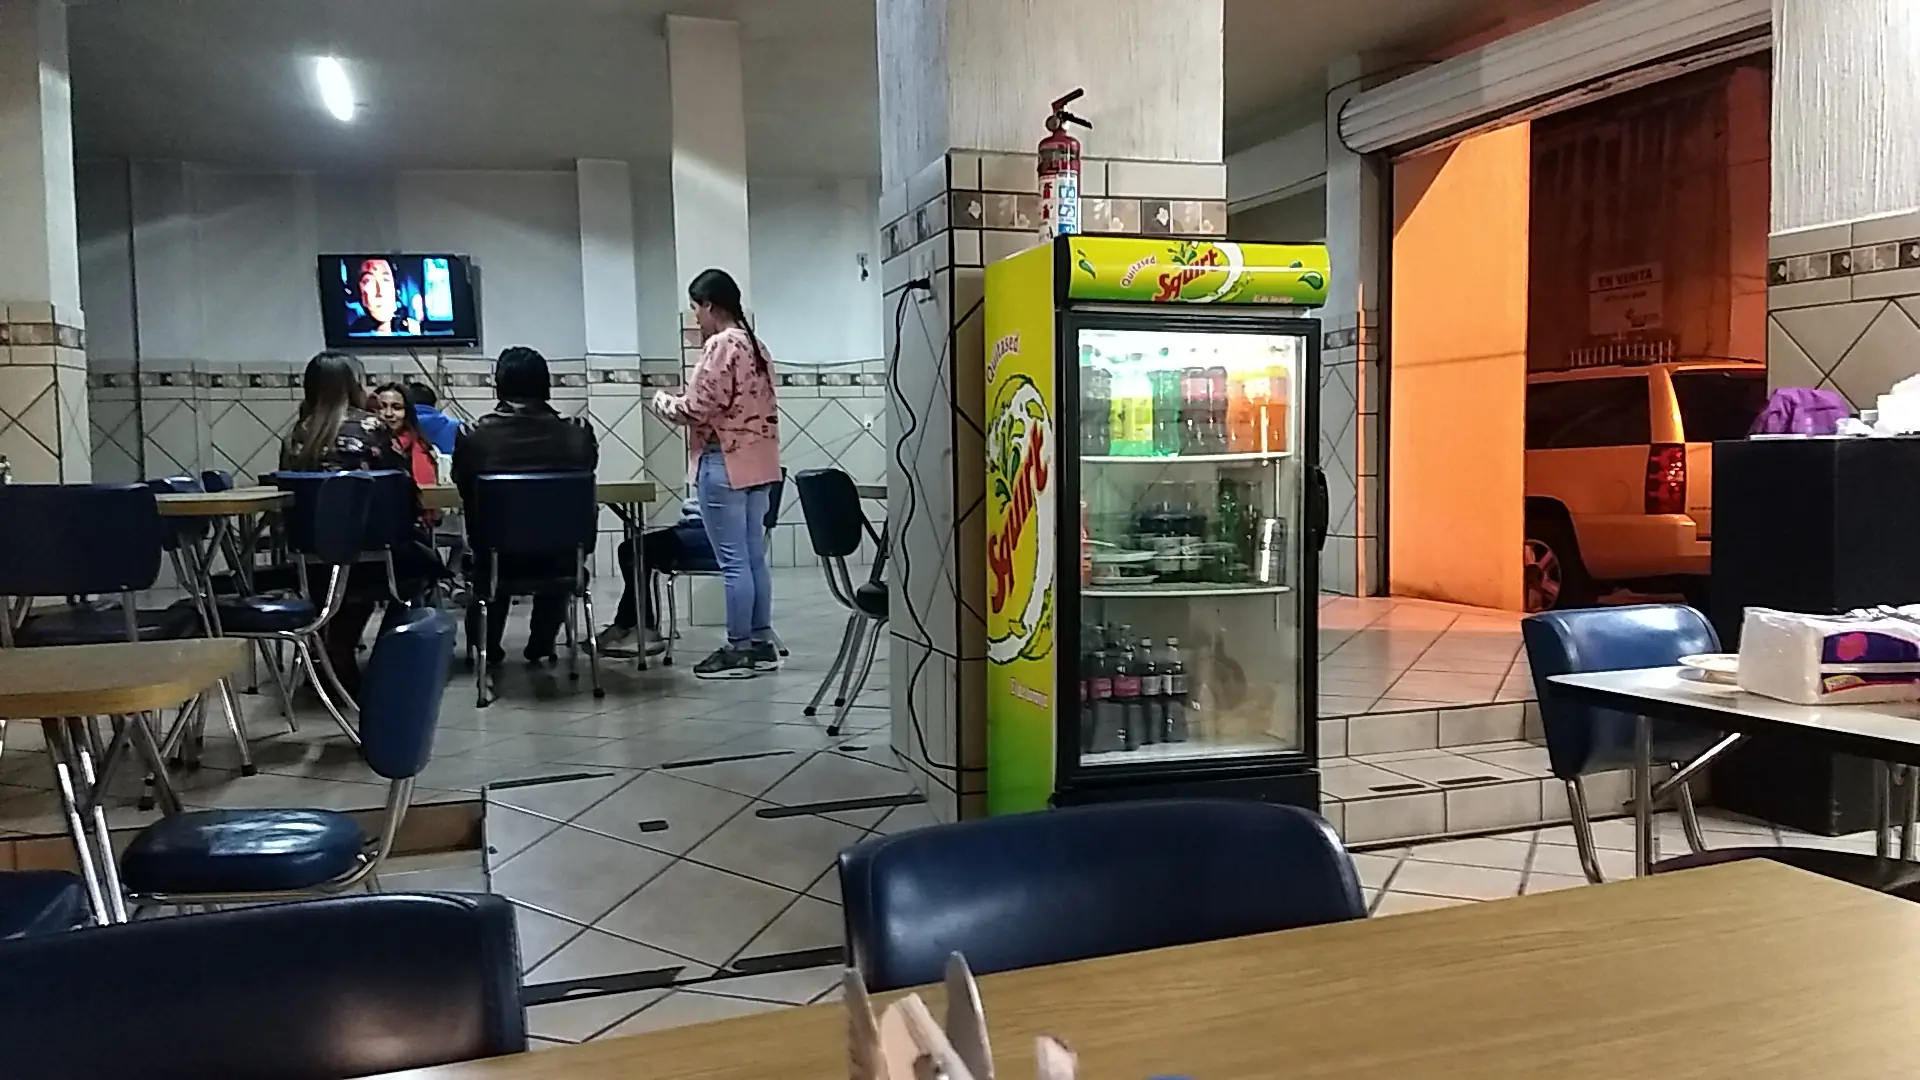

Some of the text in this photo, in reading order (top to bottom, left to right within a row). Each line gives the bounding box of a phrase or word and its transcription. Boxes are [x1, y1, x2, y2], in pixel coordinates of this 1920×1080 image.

[1153, 248, 1221, 302] Squirt
[1598, 268, 1653, 287] EN VENTA
[988, 420, 1048, 614] Squirt
